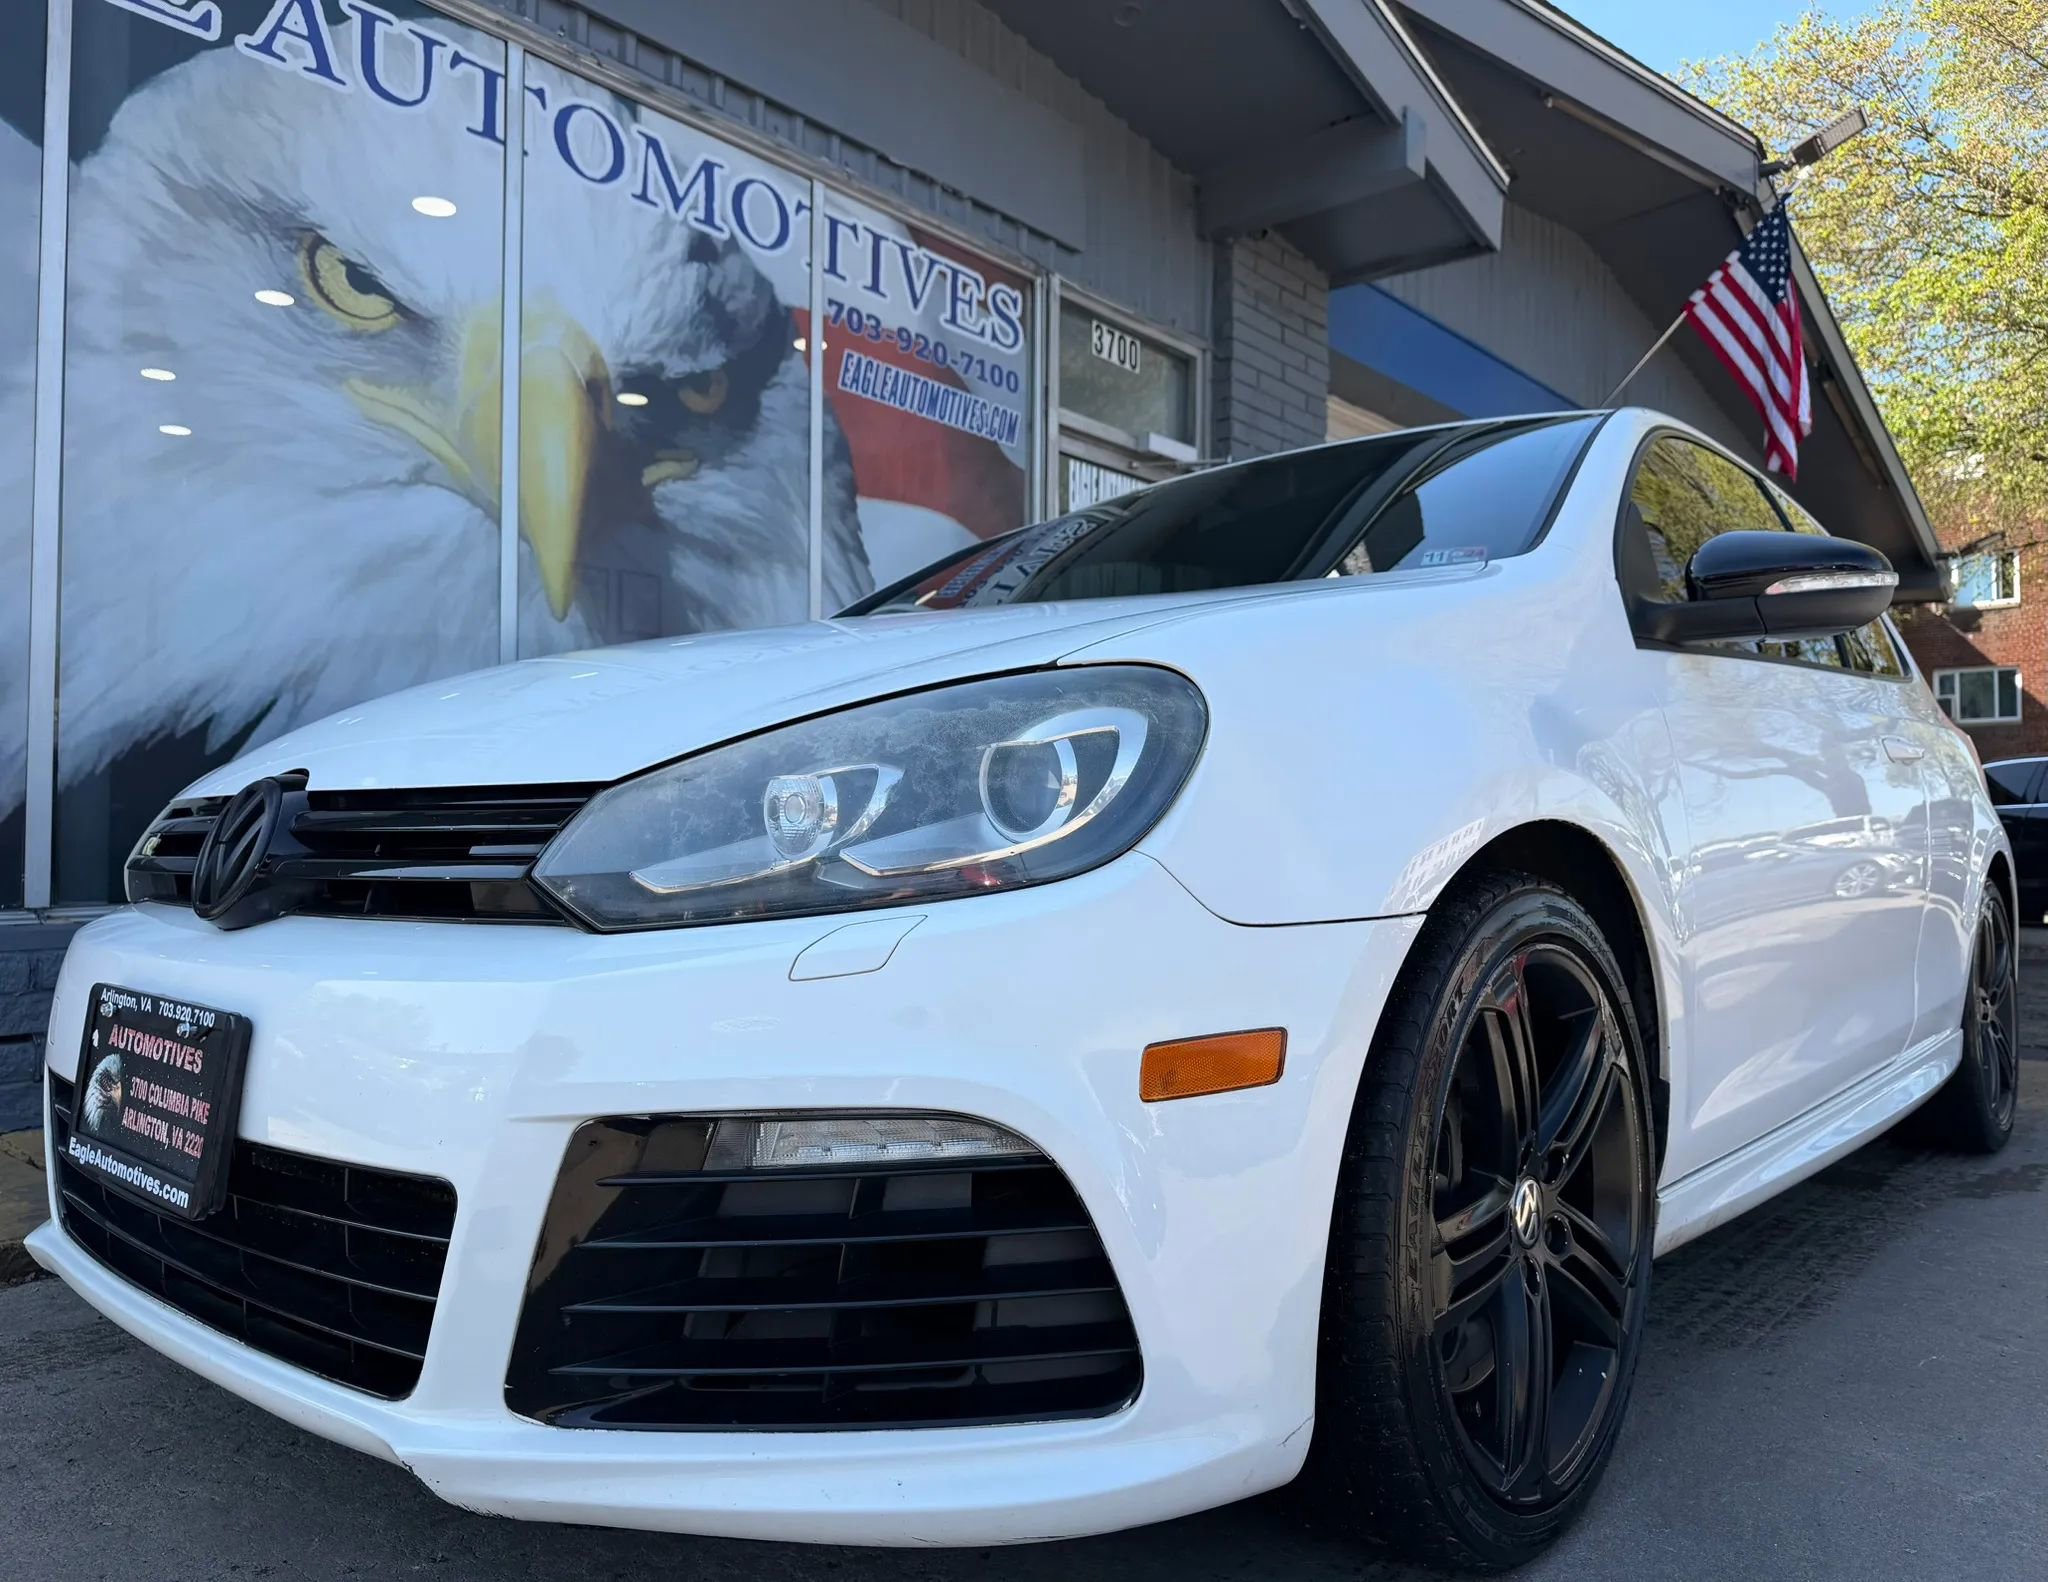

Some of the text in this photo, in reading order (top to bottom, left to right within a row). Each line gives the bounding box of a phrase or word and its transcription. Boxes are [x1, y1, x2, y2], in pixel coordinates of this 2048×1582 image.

[242, 0, 1021, 350] AUTOMOTIVES
[827, 298, 1019, 394] 703-920-7100
[1092, 323, 1139, 371] 3700
[839, 352, 1020, 445] EAGLEAUTOMOTIVES.COM
[100, 987, 216, 1028] Arlington, VA 703.920.7100
[108, 1023, 204, 1074] AUTOMOTIVES
[129, 1076, 211, 1125] 3700 COLUMBIA PIKE
[121, 1106, 169, 1149] ARLINGTON,
[171, 1125, 184, 1150] VA
[69, 1136, 190, 1209] EagleAutomotives.com
